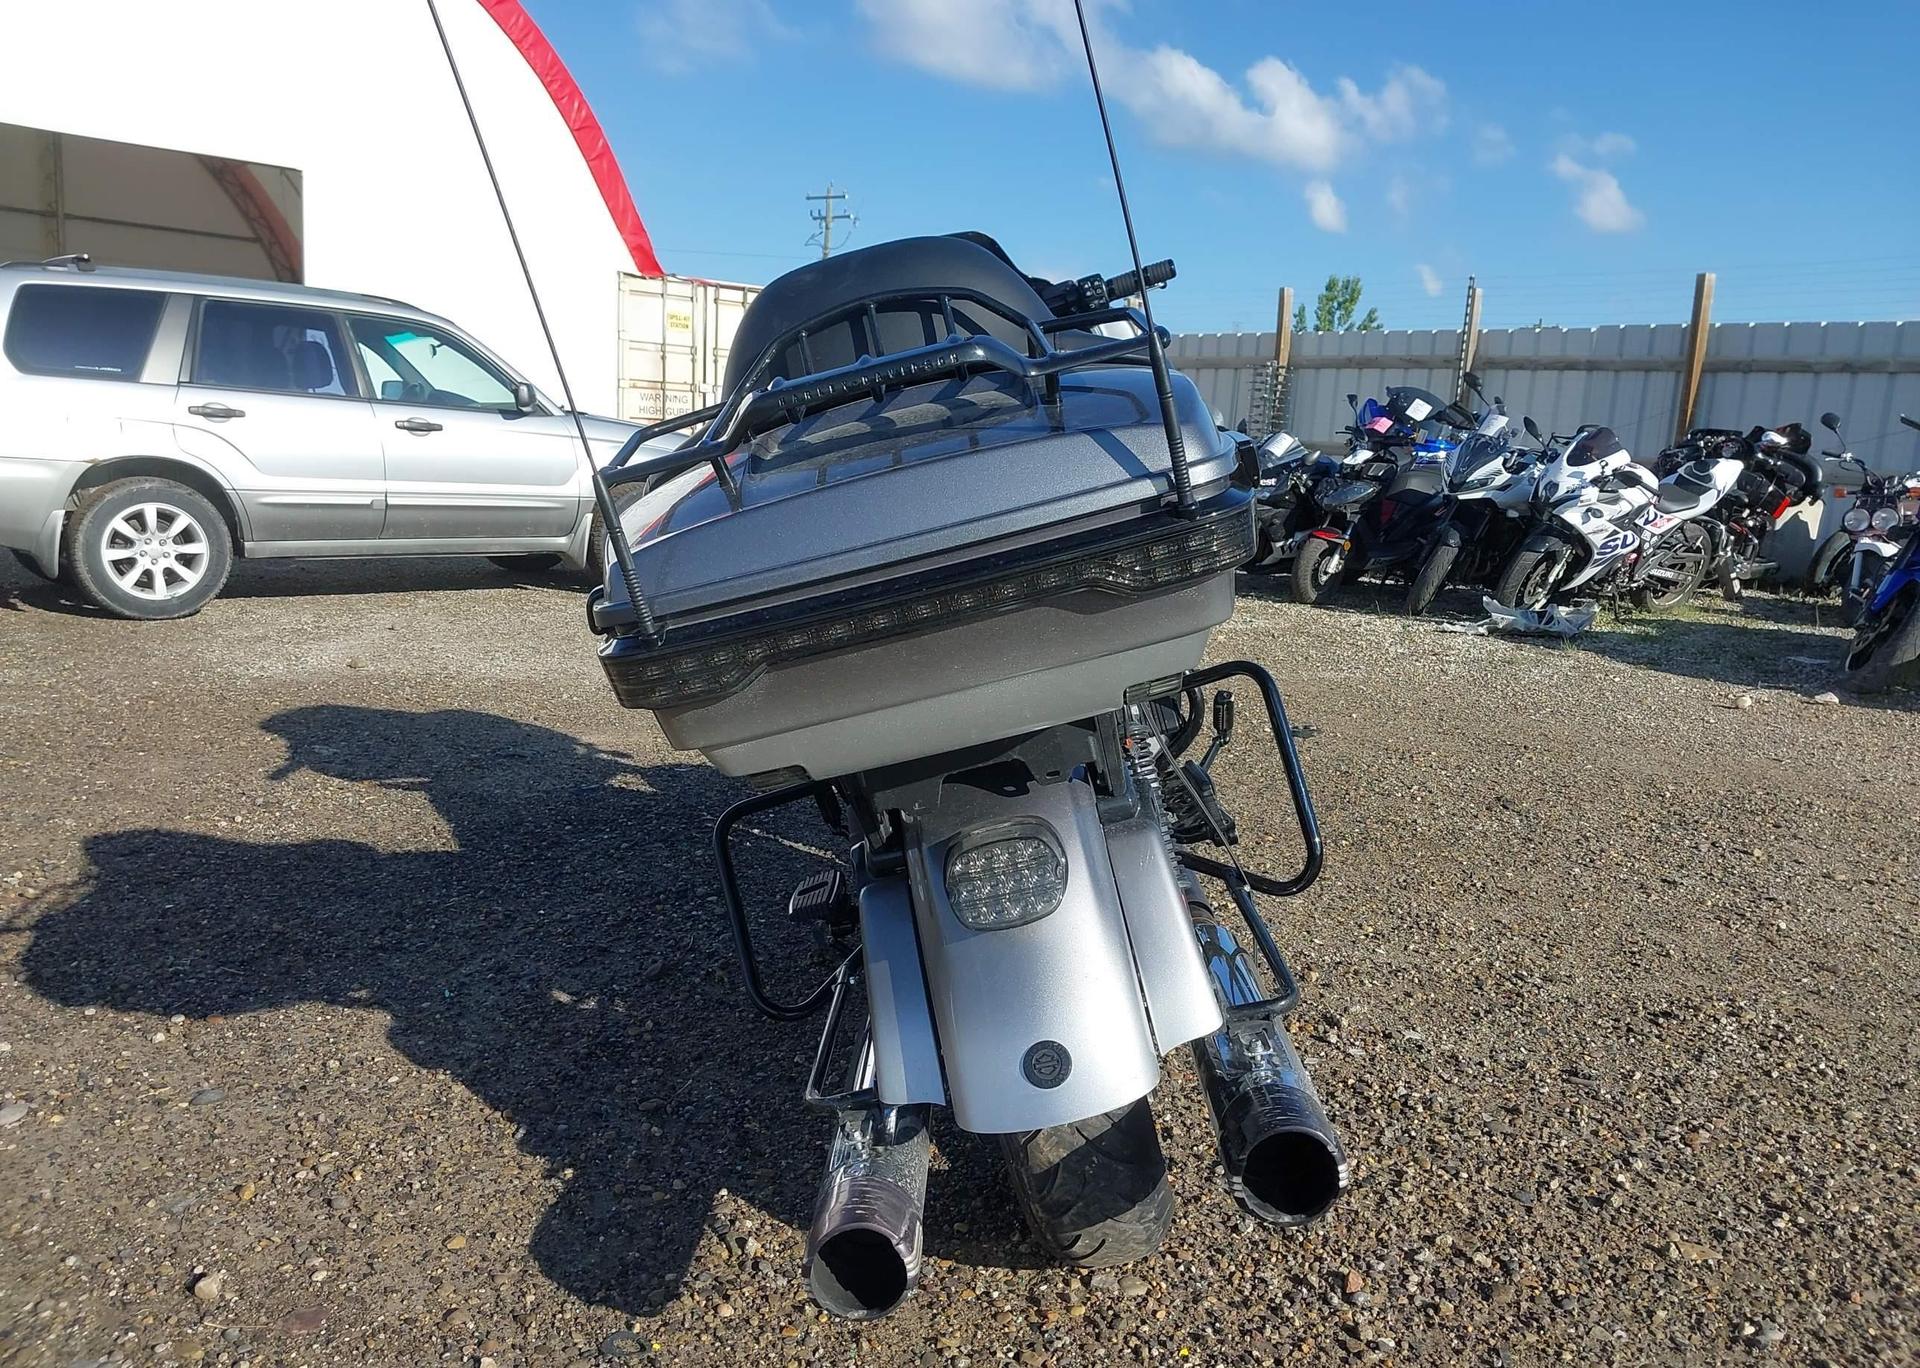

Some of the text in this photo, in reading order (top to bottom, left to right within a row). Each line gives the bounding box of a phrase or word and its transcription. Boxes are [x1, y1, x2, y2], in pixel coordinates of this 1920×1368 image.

[639, 392, 689, 404] WARNING
[638, 405, 662, 416] HIGH
[1648, 568, 1674, 579] SUZUKI
